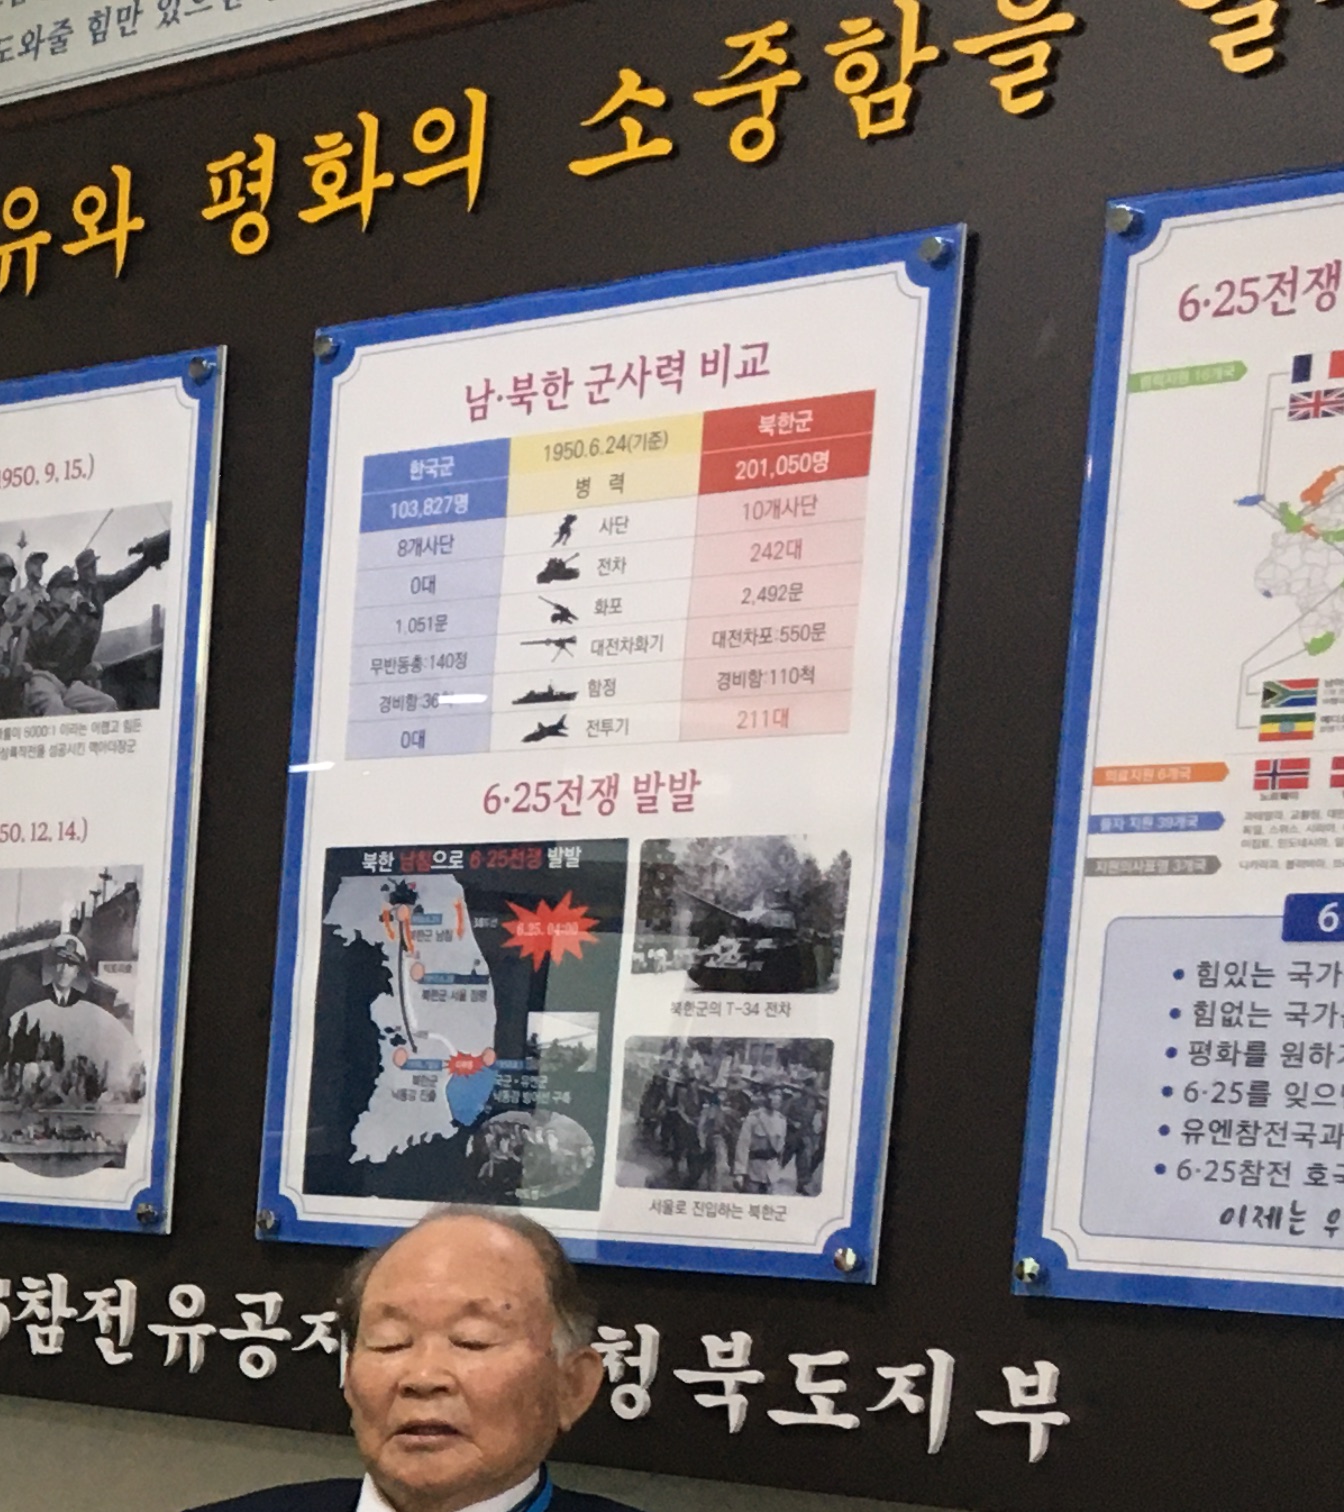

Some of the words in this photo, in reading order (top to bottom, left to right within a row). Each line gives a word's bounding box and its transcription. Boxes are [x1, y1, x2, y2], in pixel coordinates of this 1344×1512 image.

[88, 0, 144, 46] 힘만
[201, 87, 488, 256] 평화의
[568, 0, 1084, 178] 소중함을
[1178, 259, 1344, 323] 6·25전쟁
[464, 367, 574, 422] 남·북한
[583, 349, 687, 406] 군사력
[700, 340, 772, 390] 비교
[758, 408, 815, 438] 북한군
[543, 429, 670, 463] 1950.6.24(기준)
[409, 455, 456, 482] 한국군
[734, 450, 831, 483] 201,050명
[389, 493, 469, 521] 103,827명
[742, 495, 819, 522] 10개사단
[598, 515, 630, 537] 사단
[397, 533, 456, 560] 8개사단
[749, 540, 803, 564] 242대
[596, 555, 627, 578] 전차
[410, 574, 438, 597] 0대
[593, 596, 624, 618] 화포
[590, 631, 665, 658] 대전차화기
[711, 621, 829, 651] 대전차포:550문
[587, 677, 617, 699] 함정
[716, 664, 817, 693] 경비함:110척
[585, 717, 630, 739] 전투기
[736, 707, 791, 733] 211대
[400, 728, 427, 751] 0대
[482, 771, 620, 818] 6·25전쟁
[632, 767, 703, 814] 발발
[362, 851, 394, 873] 북한
[547, 845, 582, 869] 발발
[1197, 961, 1275, 990] 힘있는
[670, 1000, 723, 1018] 북한군의
[726, 1001, 760, 1017] T-34
[764, 1001, 792, 1018] 전차
[1193, 999, 1272, 1030] 힘없는
[1284, 999, 1344, 1030] 국가
[1188, 1040, 1269, 1070] 평화를
[1183, 1079, 1271, 1108] 6·25를
[1284, 1080, 1344, 1110] 잊으
[1177, 1159, 1292, 1190] 6·25참전
[649, 1198, 687, 1216] 서울로
[693, 1200, 744, 1220] 진입하는
[748, 1203, 788, 1222] 북한군
[1220, 1199, 1306, 1237] 이제는
[590, 1323, 1071, 1464] 청북도지부
